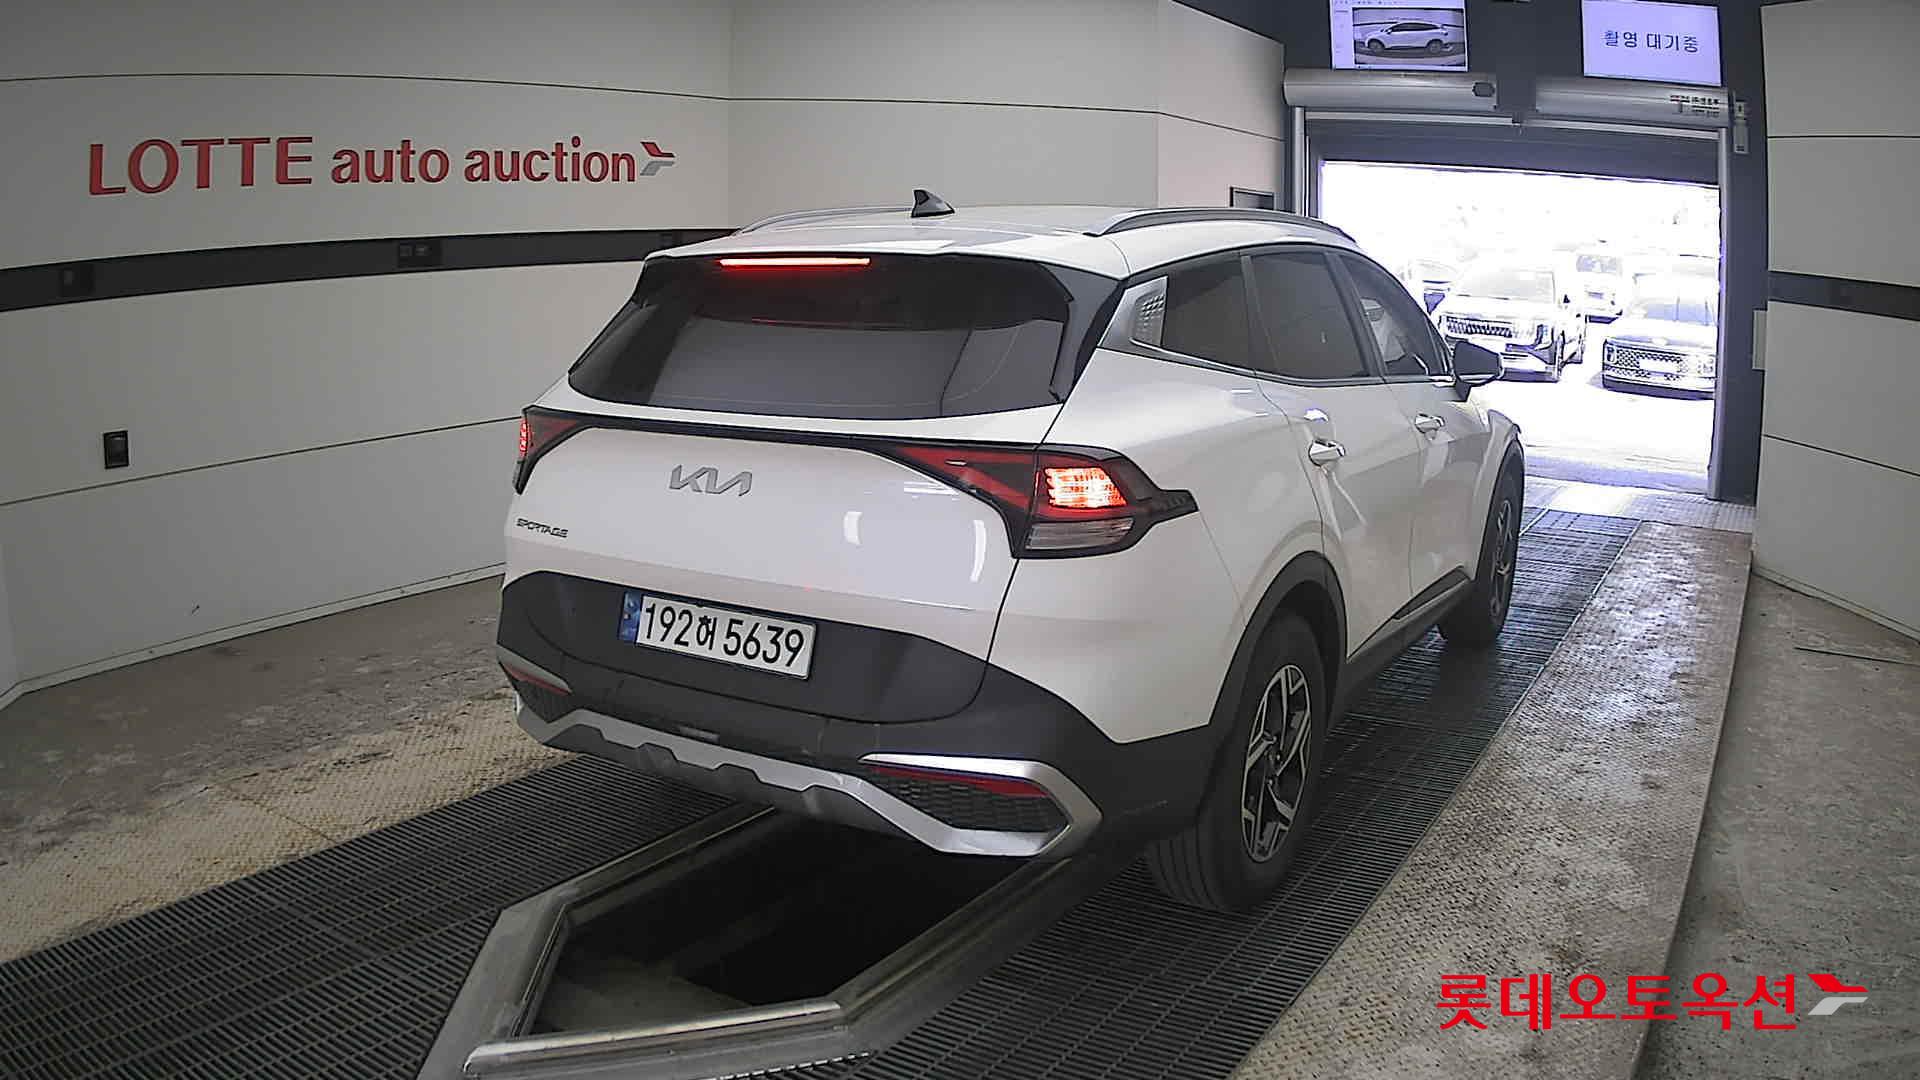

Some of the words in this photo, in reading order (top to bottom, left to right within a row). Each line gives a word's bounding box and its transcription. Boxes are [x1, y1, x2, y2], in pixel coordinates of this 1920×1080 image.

[1646, 33, 1698, 53] 대기중
[88, 136, 313, 196] LOTTE
[331, 139, 450, 185] auto
[463, 135, 636, 183] auction
[668, 464, 753, 497] KIA
[516, 517, 569, 539] SPORTAGE
